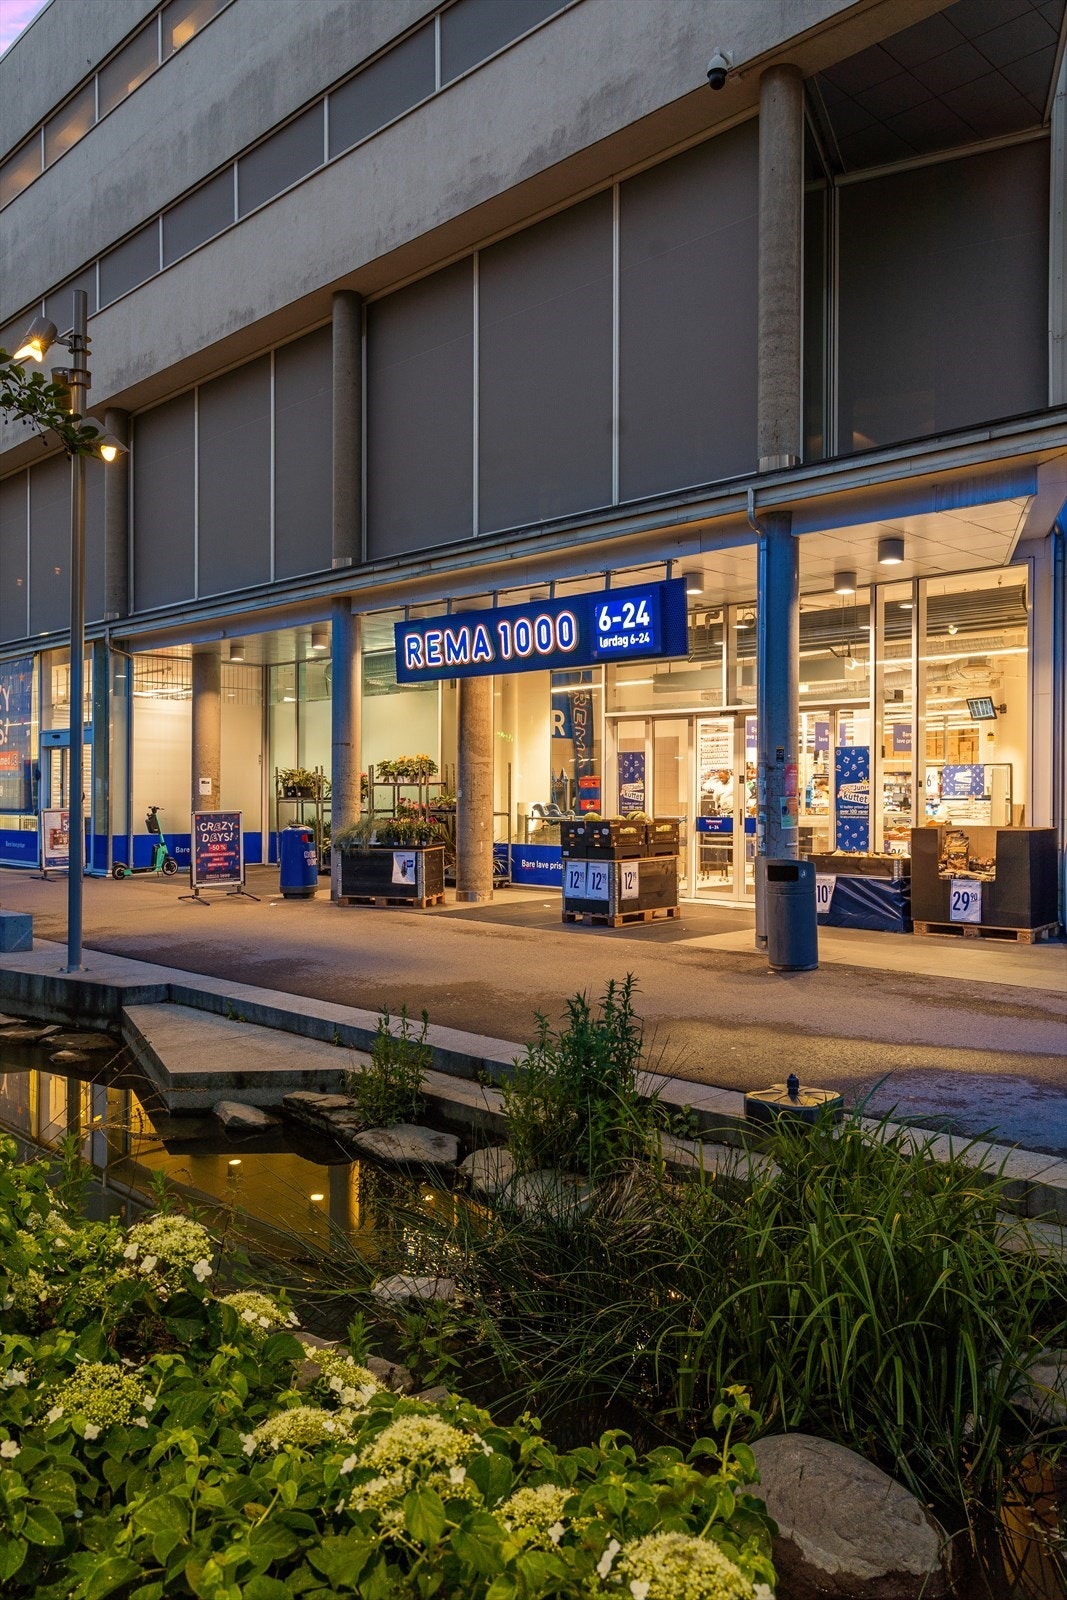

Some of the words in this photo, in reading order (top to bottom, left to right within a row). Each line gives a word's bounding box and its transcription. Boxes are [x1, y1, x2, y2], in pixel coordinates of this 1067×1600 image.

[599, 600, 650, 631] 6-24
[404, 623, 493, 670] REMA
[498, 610, 578, 661] 1000
[630, 632, 650, 645] 6-24
[843, 791, 868, 804] kuttet
[175, 846, 190, 854] Bare
[521, 859, 536, 868] Bare
[537, 860, 549, 869] lave
[570, 871, 580, 889] 12
[592, 872, 602, 890] 12
[624, 871, 633, 890] 12
[817, 885, 828, 903] 10
[953, 891, 970, 911] 29
[970, 893, 978, 901] 90
